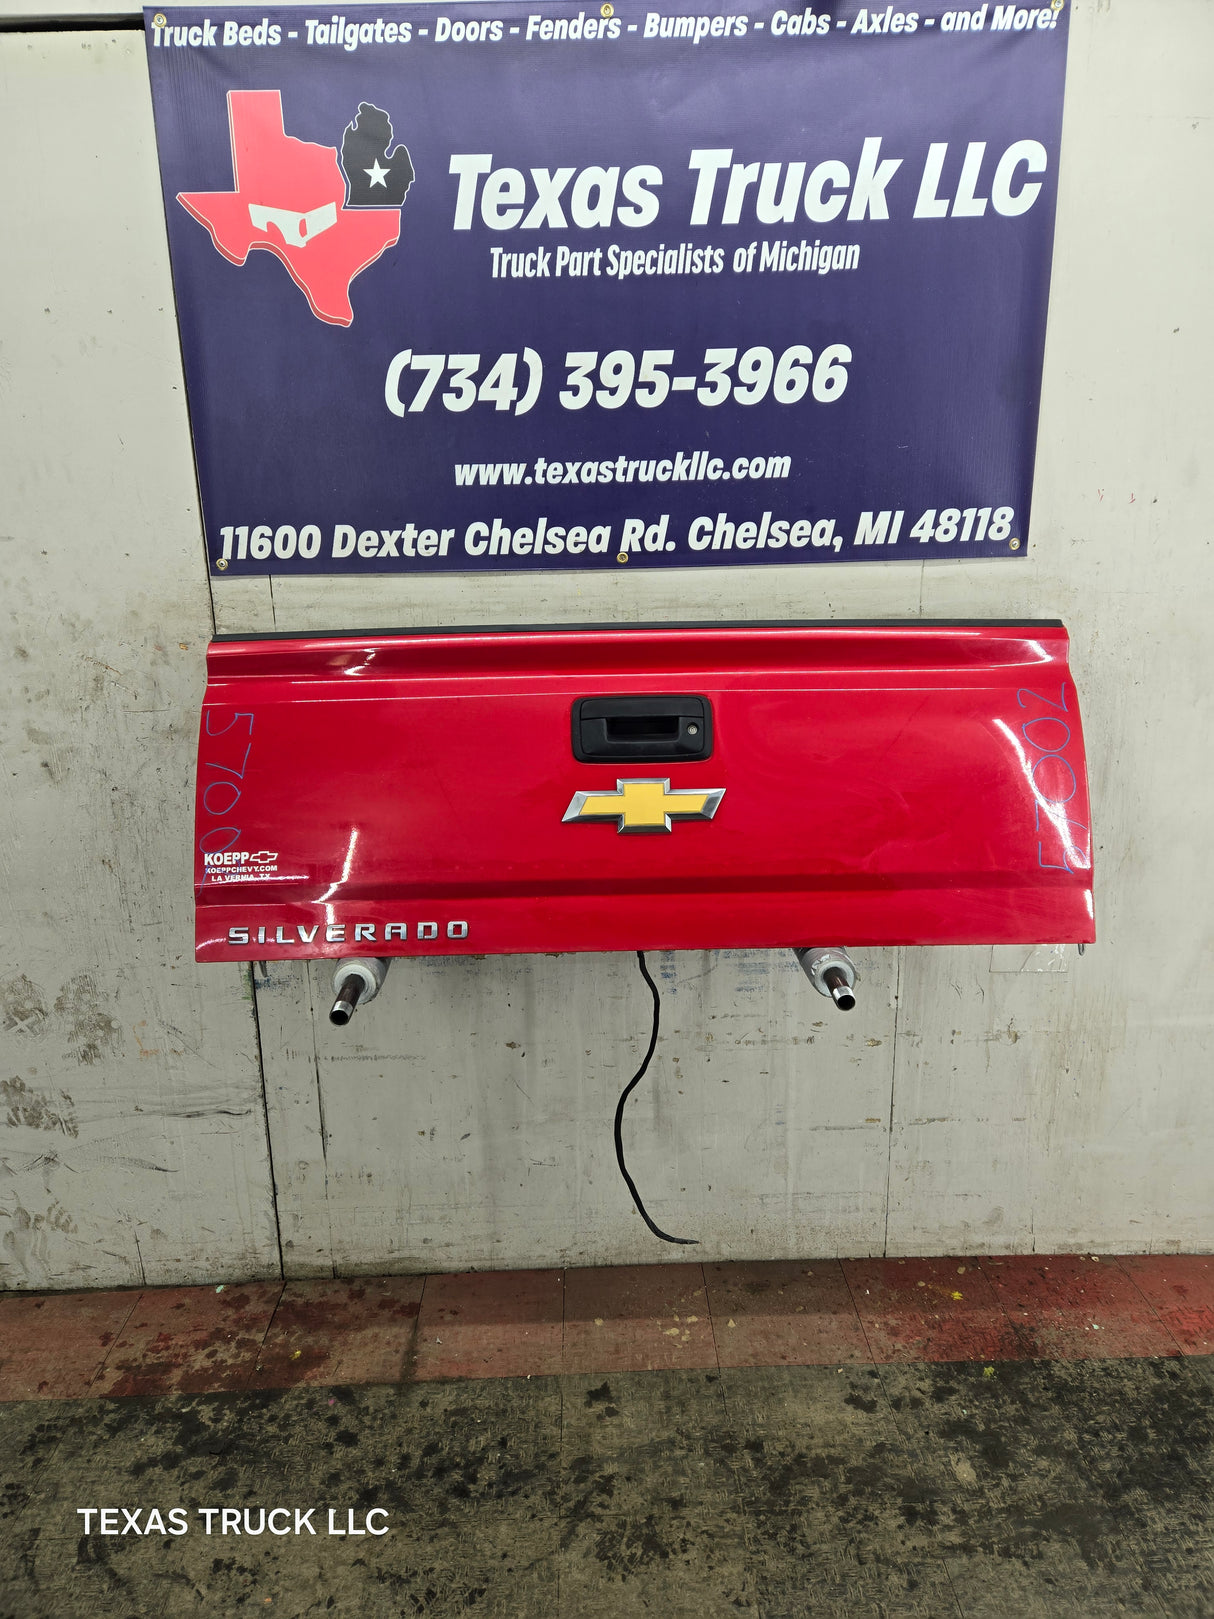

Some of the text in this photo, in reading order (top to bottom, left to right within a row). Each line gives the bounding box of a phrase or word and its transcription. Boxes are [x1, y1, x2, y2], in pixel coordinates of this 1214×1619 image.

[151, 19, 218, 47] Truck
[223, 18, 282, 47] Beds
[305, 15, 412, 51] Tailgates
[434, 17, 503, 42] Doors
[525, 12, 621, 41] Fenders
[643, 12, 748, 44] Bumpers
[770, 7, 830, 36] Cabs
[850, 5, 918, 35] Axles
[940, 3, 989, 31] and
[990, 4, 1060, 30] More!
[448, 136, 1048, 230] Texas Truck LLC
[490, 239, 860, 280] Truck Part Specialists of Michigan
[385, 344, 852, 417] (734) 395-3966
[454, 451, 791, 486] www.texastruckllc.com
[220, 506, 1015, 560] 11600 Dexter Chelsea Rd. Chelsea, MI 48118
[204, 852, 249, 866] KOEPP
[205, 865, 278, 874] KOEPPCHEVY.COM
[228, 921, 470, 945] SILVERADO
